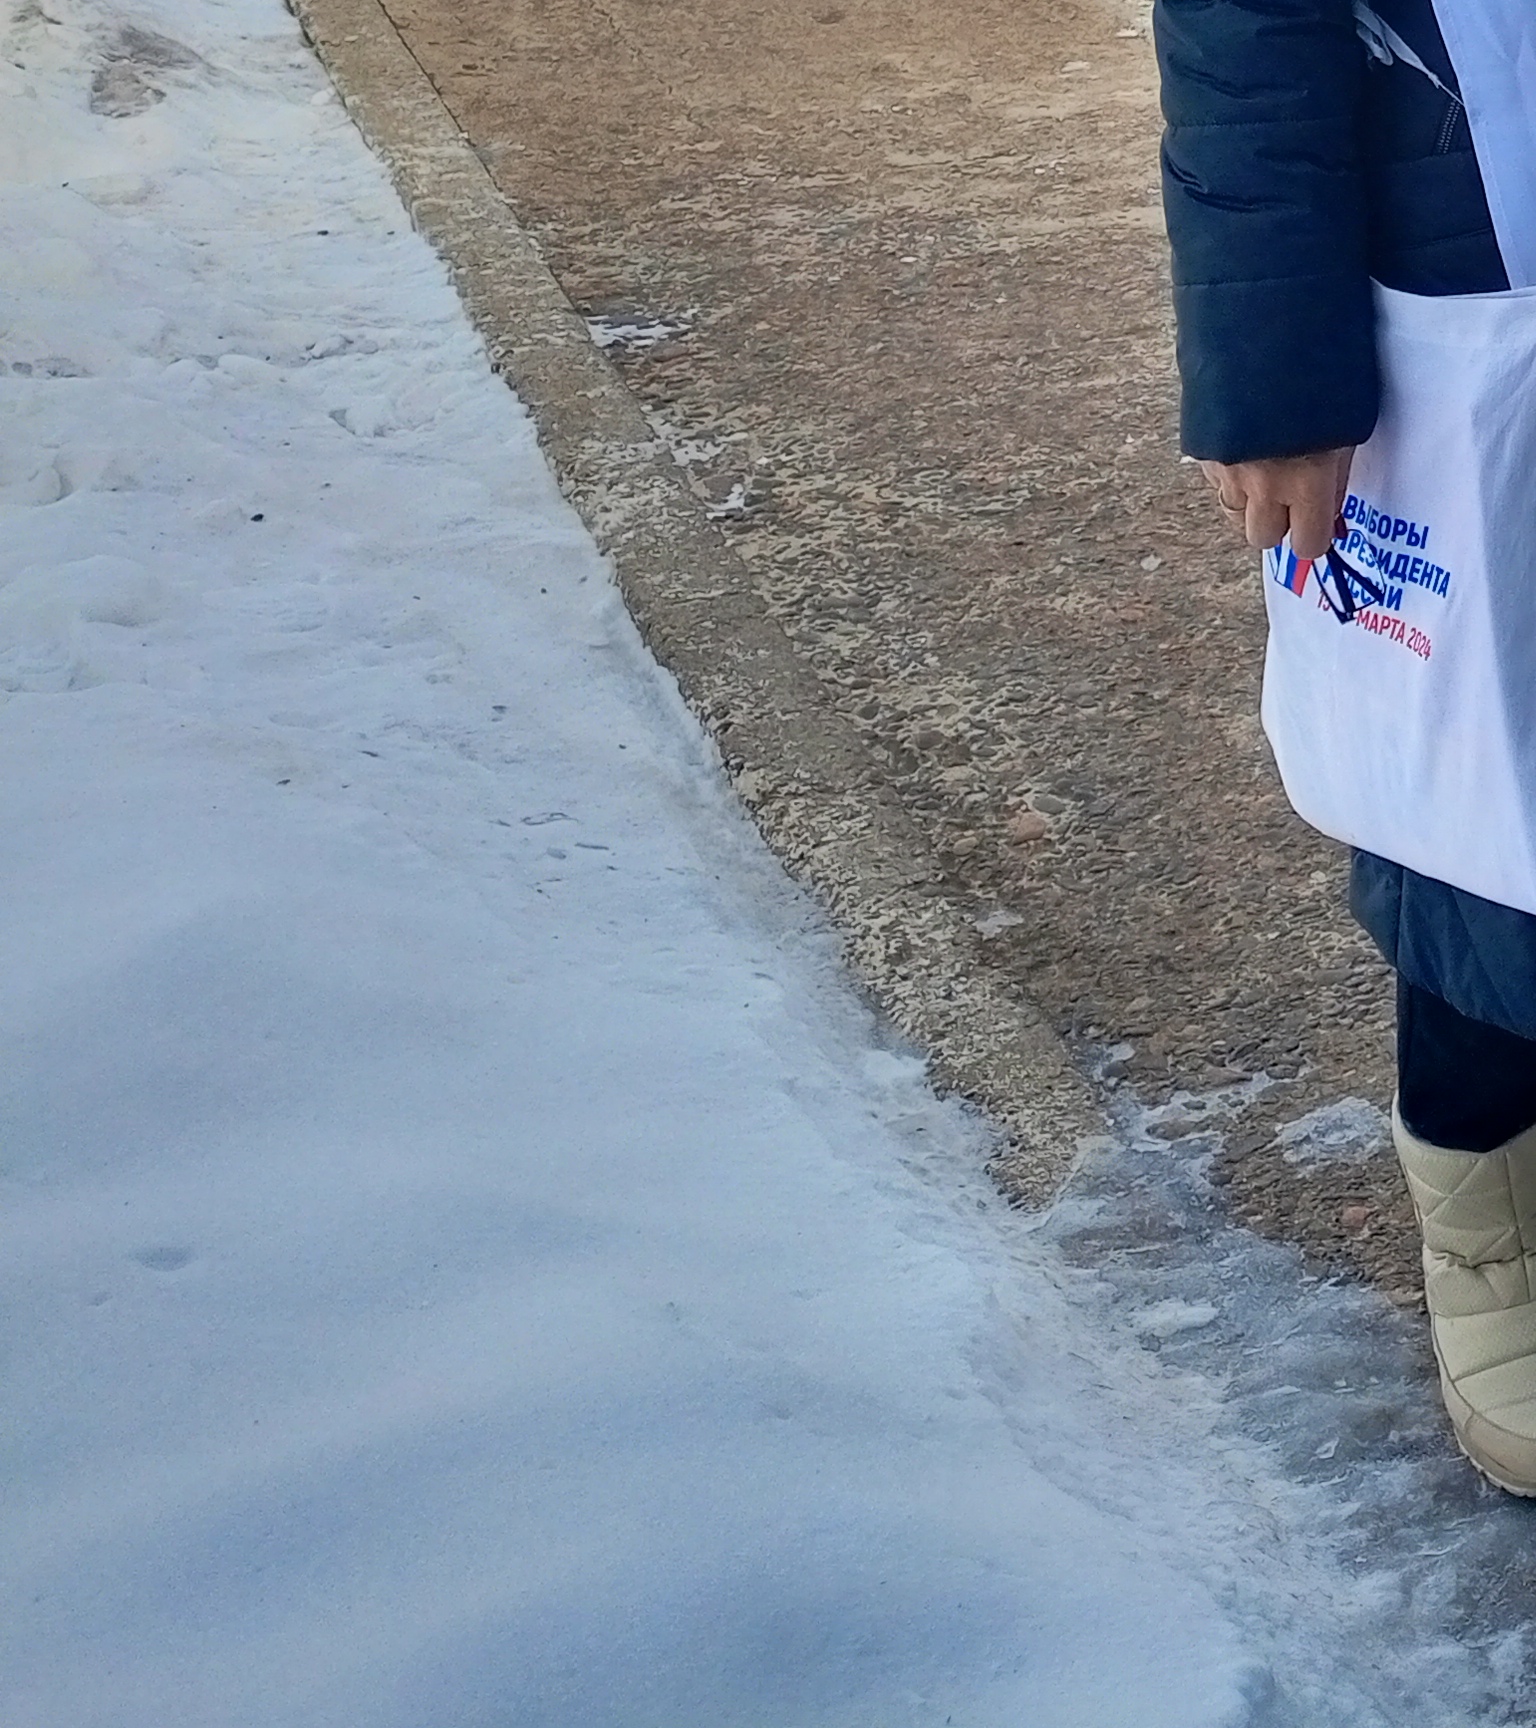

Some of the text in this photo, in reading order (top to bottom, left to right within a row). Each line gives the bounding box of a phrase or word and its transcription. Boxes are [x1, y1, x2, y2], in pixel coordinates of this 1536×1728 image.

[1343, 494, 1430, 550] ВЫБОРЫ
[1356, 609, 1432, 662] МАРТА 2024
